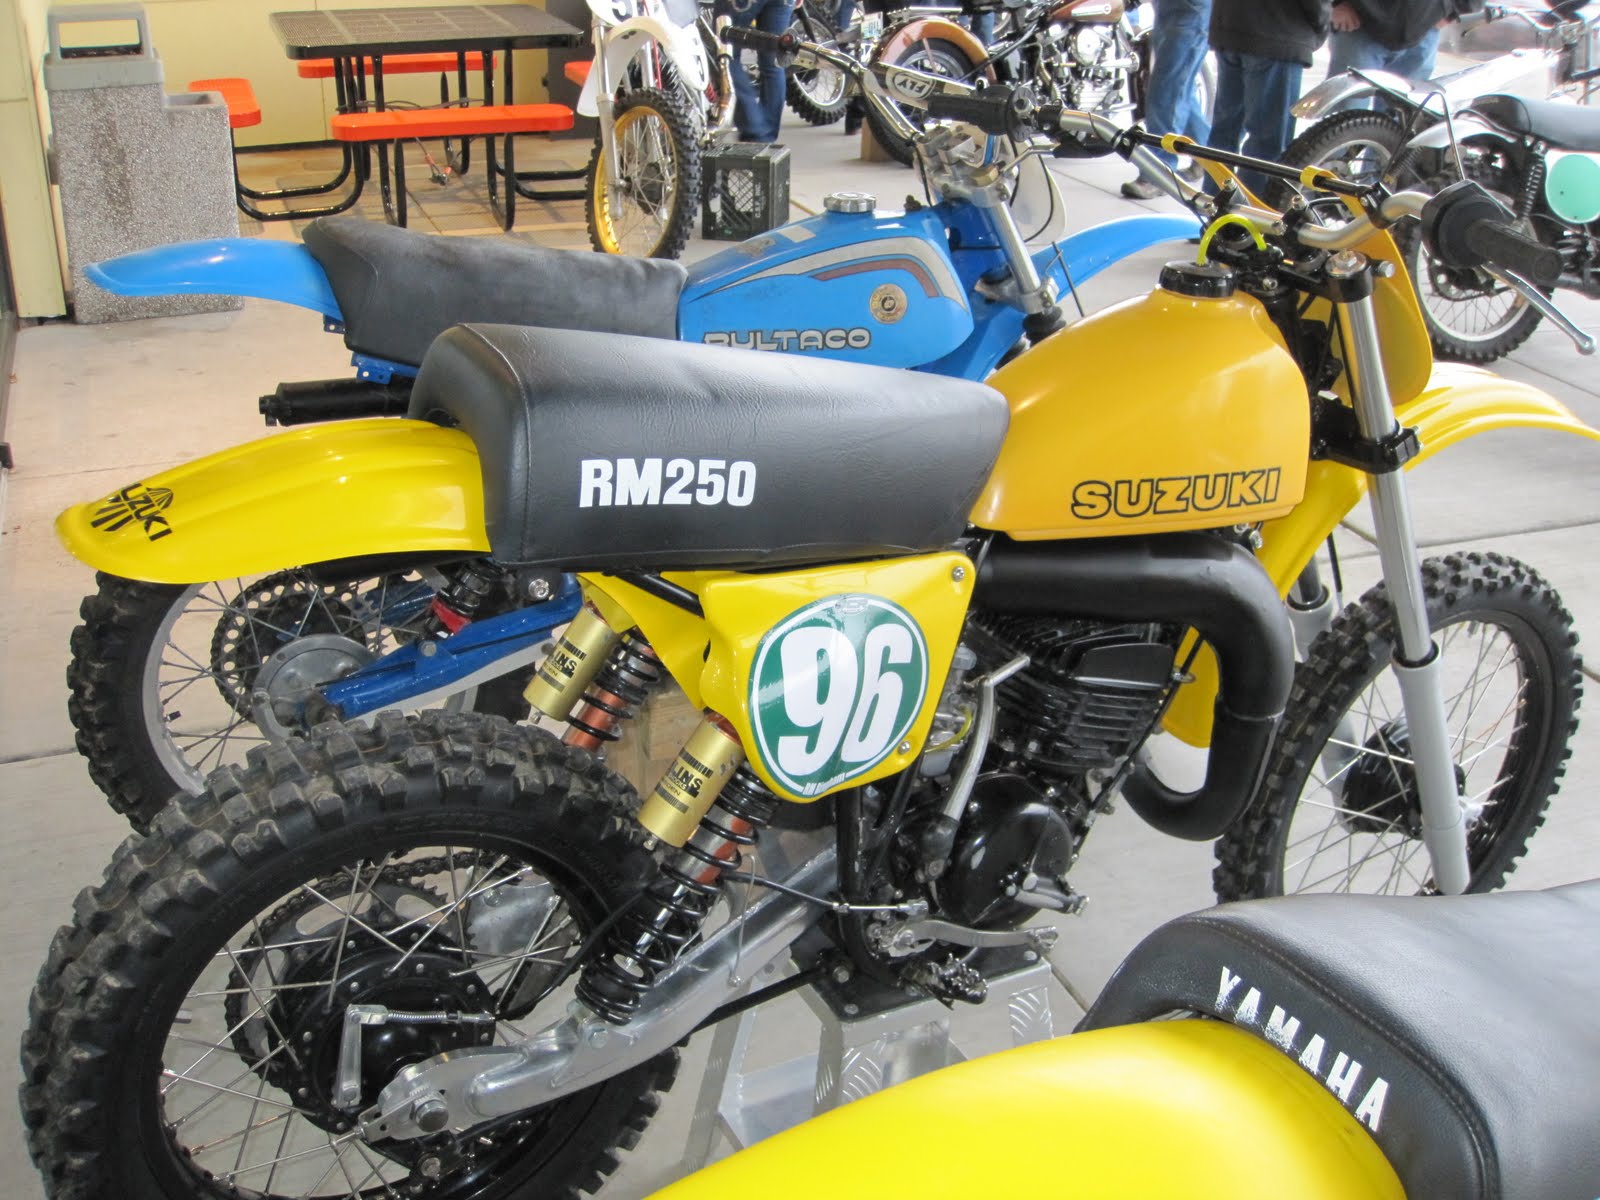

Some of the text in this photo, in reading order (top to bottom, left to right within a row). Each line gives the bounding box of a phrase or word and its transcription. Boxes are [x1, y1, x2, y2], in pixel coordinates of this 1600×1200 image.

[897, 78, 927, 94] FLY
[579, 458, 757, 508] RM250
[1071, 467, 1281, 520] SUZUKI
[120, 483, 173, 542] UZUKI
[777, 623, 914, 776] 96
[1214, 966, 1389, 1132] YAMAHA
